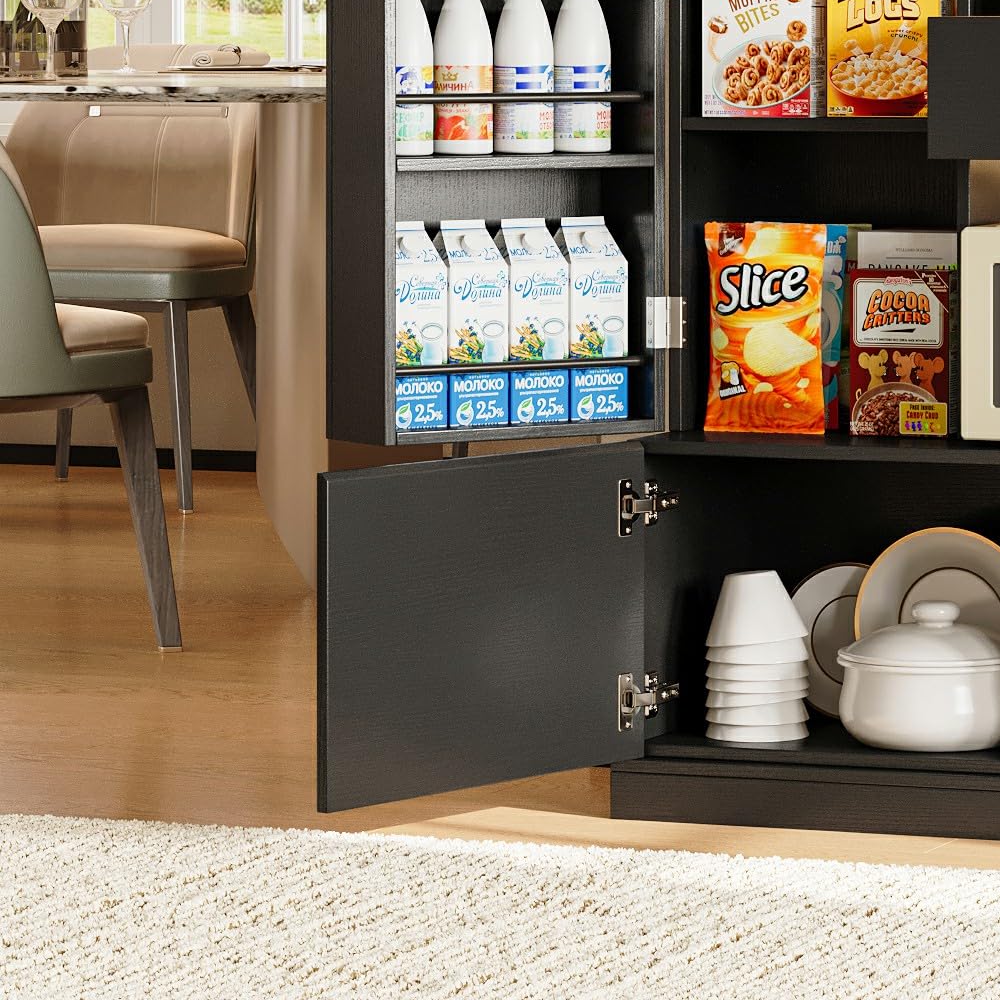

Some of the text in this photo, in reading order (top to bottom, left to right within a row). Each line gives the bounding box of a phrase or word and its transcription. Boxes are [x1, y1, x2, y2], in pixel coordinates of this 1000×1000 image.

[734, 4, 780, 33] BITES
[453, 279, 502, 302] Долина
[515, 276, 562, 300] Долина
[575, 275, 622, 298] Долина
[716, 263, 809, 315] Slice
[866, 289, 930, 314] COCOA
[862, 311, 931, 331] CRITTERS
[396, 381, 443, 395] МОЛОКО
[454, 378, 504, 392] МОЛОКО
[515, 375, 564, 389] МОЛОКО
[575, 373, 624, 387] МОЛОКО
[414, 403, 443, 424] 2,5%
[476, 400, 504, 421] 2,5%
[537, 397, 564, 418] 2,5%
[596, 394, 624, 415] 2,5%
